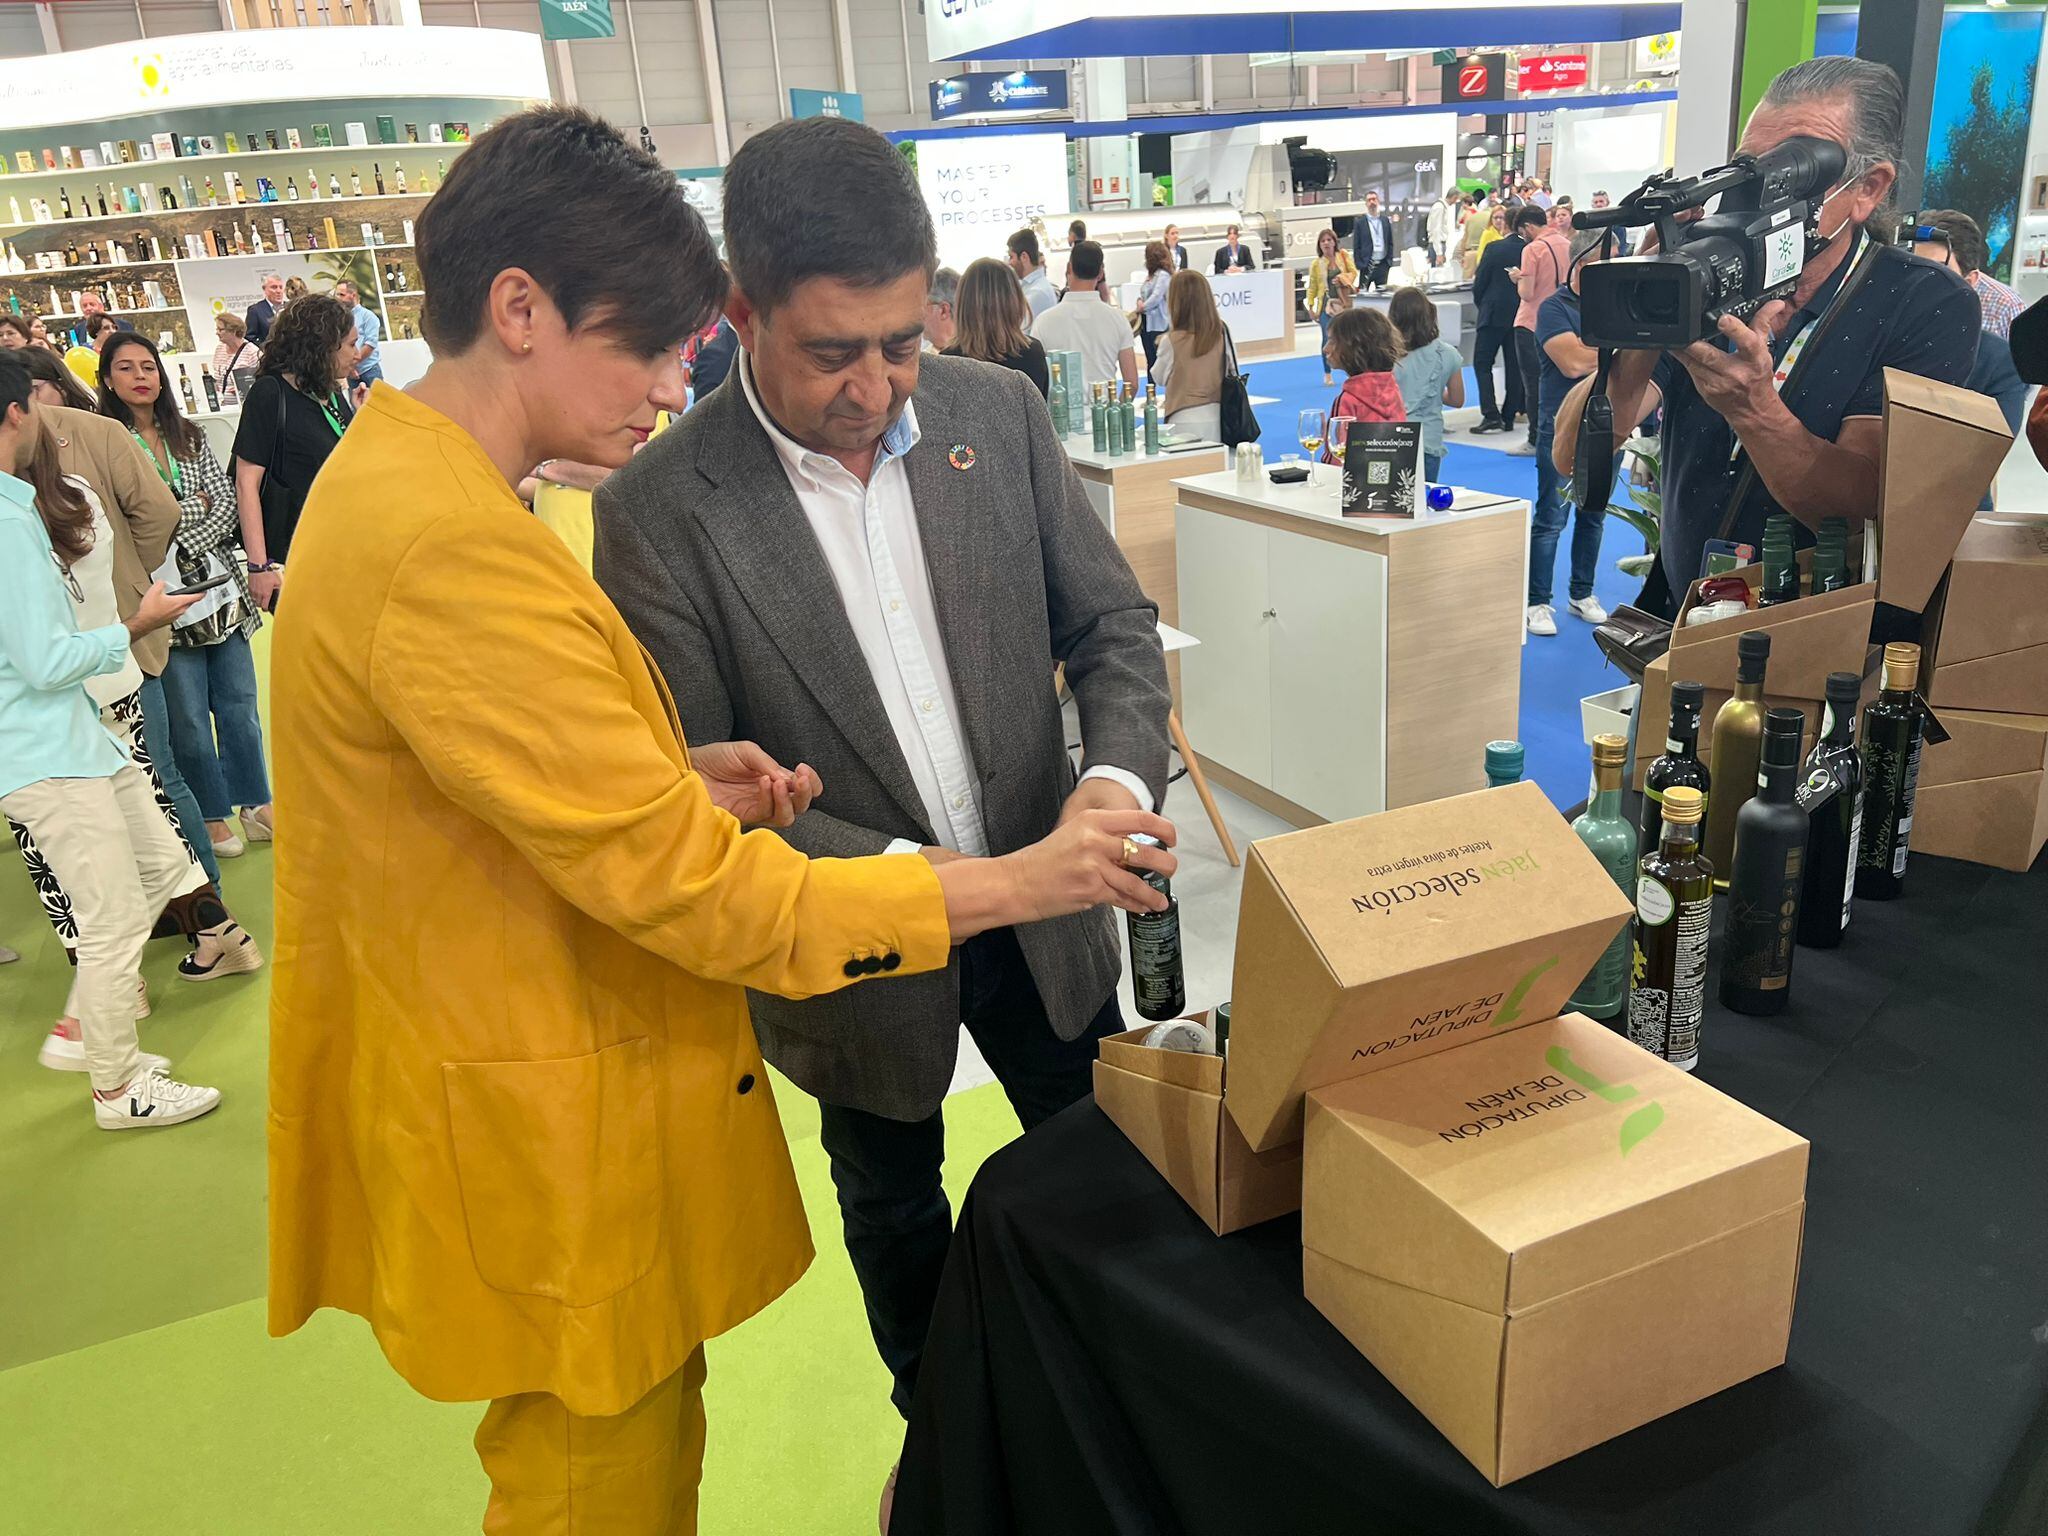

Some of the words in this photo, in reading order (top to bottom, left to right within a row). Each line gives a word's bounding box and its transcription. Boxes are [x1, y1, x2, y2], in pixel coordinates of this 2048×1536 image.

[937, 163, 1012, 182] MASTER
[1414, 161, 1437, 172] GEA
[938, 187, 991, 204] YOUR
[941, 204, 1046, 226] PROCESSES
[1213, 290, 1252, 308] COME
[1446, 847, 1460, 860] de
[1460, 839, 1493, 855] Aceites
[1394, 856, 1425, 871] virgen
[1424, 850, 1446, 865] oliva
[1366, 863, 1393, 877] extra
[1470, 992, 1504, 1011] DE
[1524, 1075, 1564, 1093] DE
[1465, 1085, 1527, 1112] JAÉN
[1438, 1089, 1587, 1143] DIPUTACIÓN
